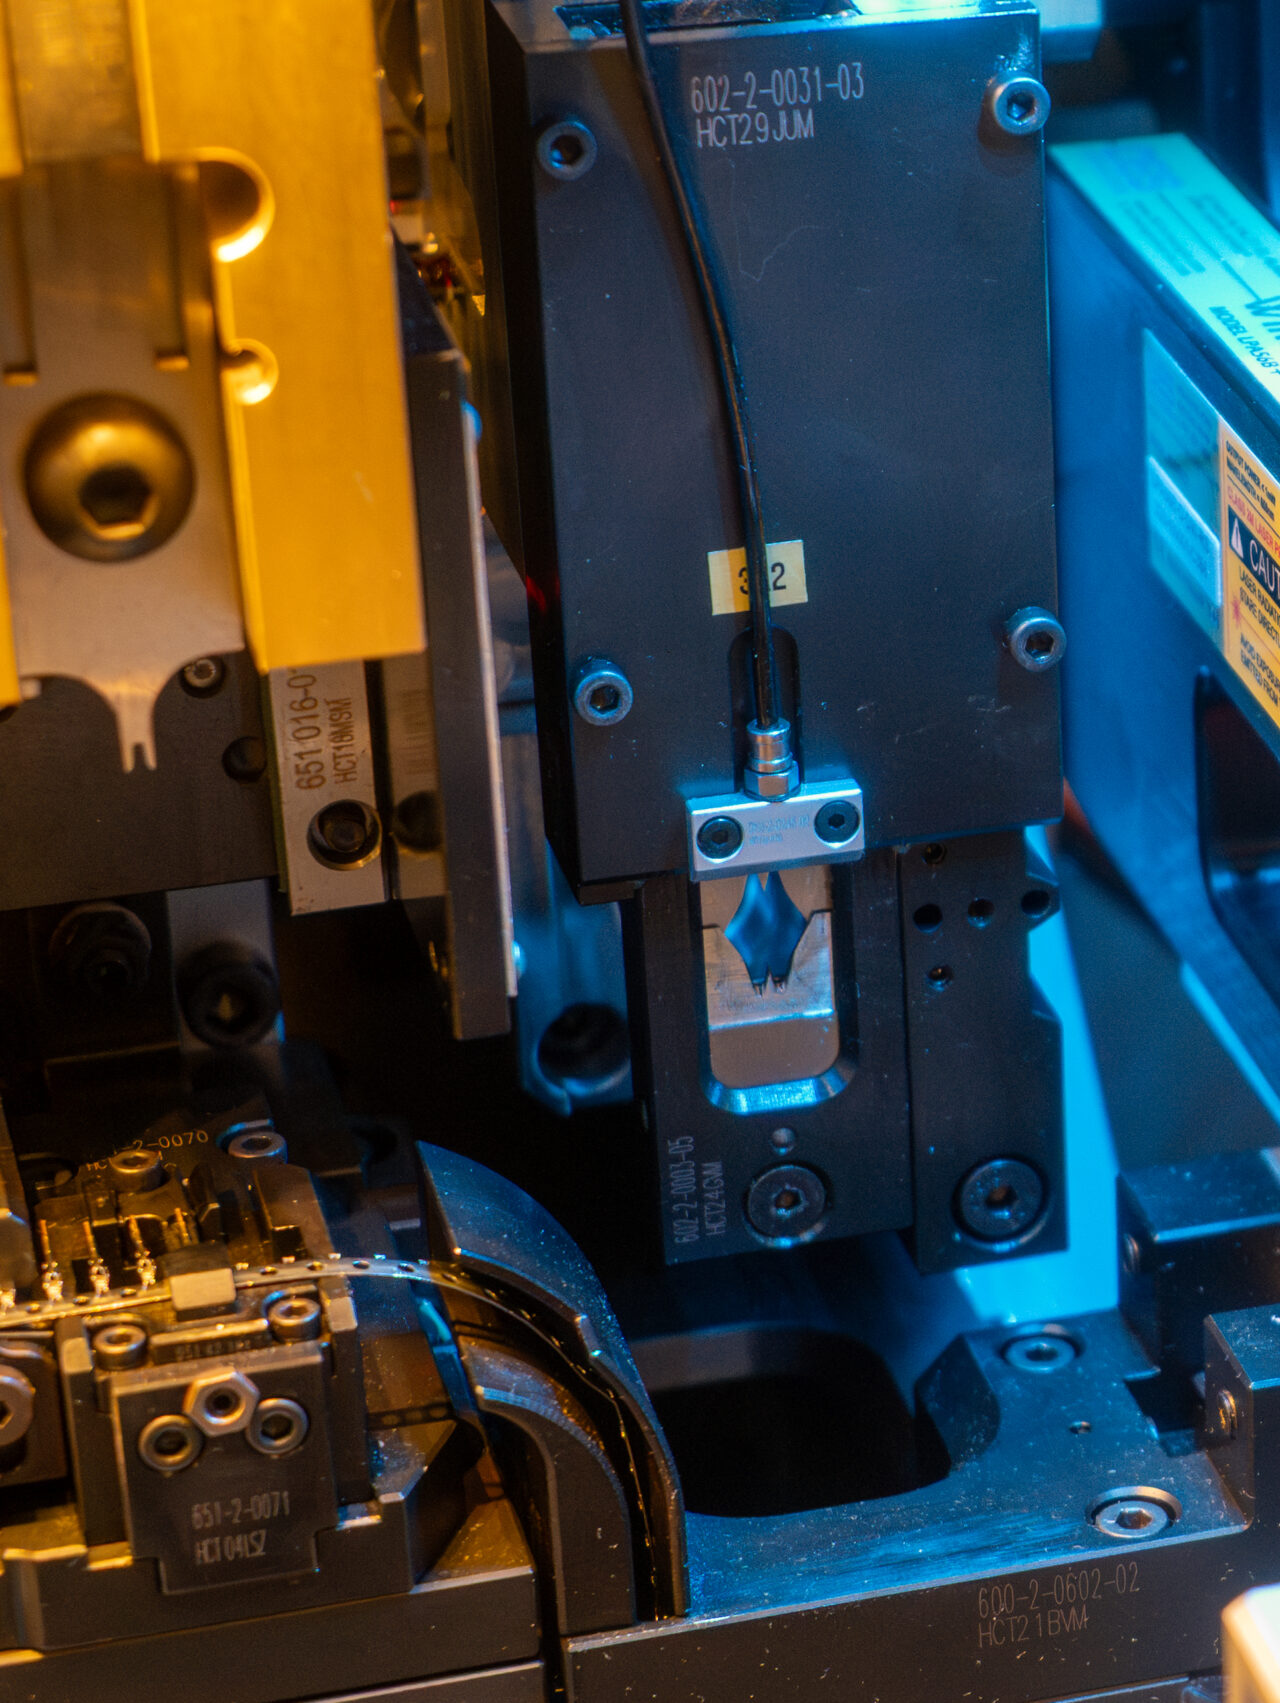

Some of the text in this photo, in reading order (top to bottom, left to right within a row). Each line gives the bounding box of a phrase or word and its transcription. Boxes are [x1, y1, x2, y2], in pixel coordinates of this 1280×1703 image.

[691, 62, 864, 113] 602-2-0031-03
[695, 108, 815, 147] HCT29JUM
[1255, 519, 1274, 550] LASER
[738, 561, 787, 595] 32
[1239, 566, 1257, 598] LASER
[1240, 585, 1258, 619] STARE
[1263, 678, 1279, 708] FROM
[192, 1491, 290, 1530] 651-2-0071
[979, 1561, 1140, 1618] 600-2-0602-02
